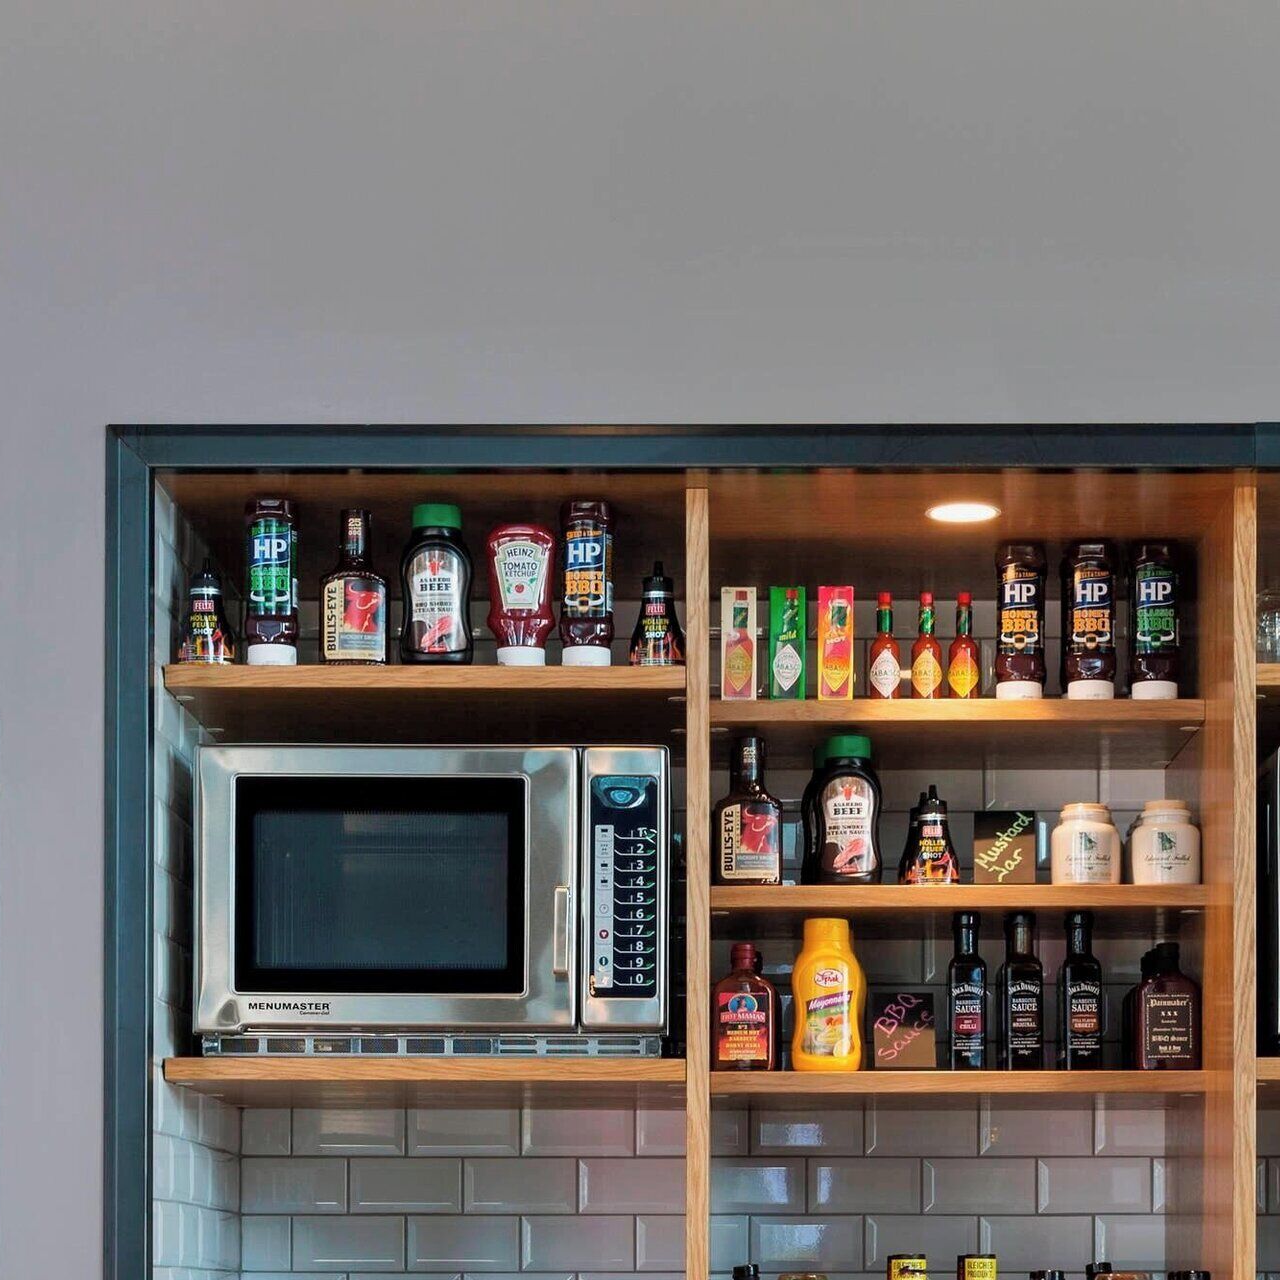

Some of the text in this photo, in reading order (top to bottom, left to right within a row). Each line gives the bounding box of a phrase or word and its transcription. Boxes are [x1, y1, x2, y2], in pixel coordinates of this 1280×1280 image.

[254, 539, 288, 560] HP
[506, 548, 534, 558] HEINZ
[568, 542, 601, 564] HP
[503, 562, 538, 571] TOMATO
[505, 570, 536, 578] KETCHUP
[566, 571, 602, 580] HONEY
[251, 576, 288, 590] BBQ
[420, 583, 452, 592] BEEF
[566, 580, 604, 595] BBQ
[1004, 583, 1036, 603] HP
[1076, 583, 1108, 602] HP
[1140, 582, 1172, 602] HP
[327, 586, 337, 650] BULL'S-EYE
[1002, 610, 1038, 618] HONEY
[1073, 609, 1110, 618] HONEY
[1002, 618, 1038, 632] BBQ
[1073, 618, 1110, 632] BBQ
[1137, 617, 1174, 632] BBQ
[834, 808, 863, 816] BEEF
[724, 810, 734, 872] BULL'S-EYE
[975, 811, 1033, 868] Mustard
[637, 844, 644, 854] 2
[922, 852, 942, 860] SHOT
[637, 860, 644, 870] 3
[988, 848, 1023, 882] Jar
[637, 876, 644, 886] 4
[637, 893, 644, 902] 5
[637, 910, 644, 918] 6
[637, 926, 644, 934] 7
[637, 942, 644, 951] 8
[637, 958, 644, 967] 9
[637, 974, 644, 984] 0
[952, 986, 964, 996] JACK
[1008, 984, 1020, 994] JACK
[1068, 986, 1080, 996] JACK
[248, 1002, 330, 1010] MENUMASTER
[955, 1005, 982, 1014] SAUCE
[1012, 1004, 1038, 1012] SAUCE
[1072, 1004, 1098, 1012] SAUCE
[875, 993, 923, 1038] BBQ
[878, 1010, 934, 1061] Sauce
[967, 1261, 993, 1270] GLEICHES
